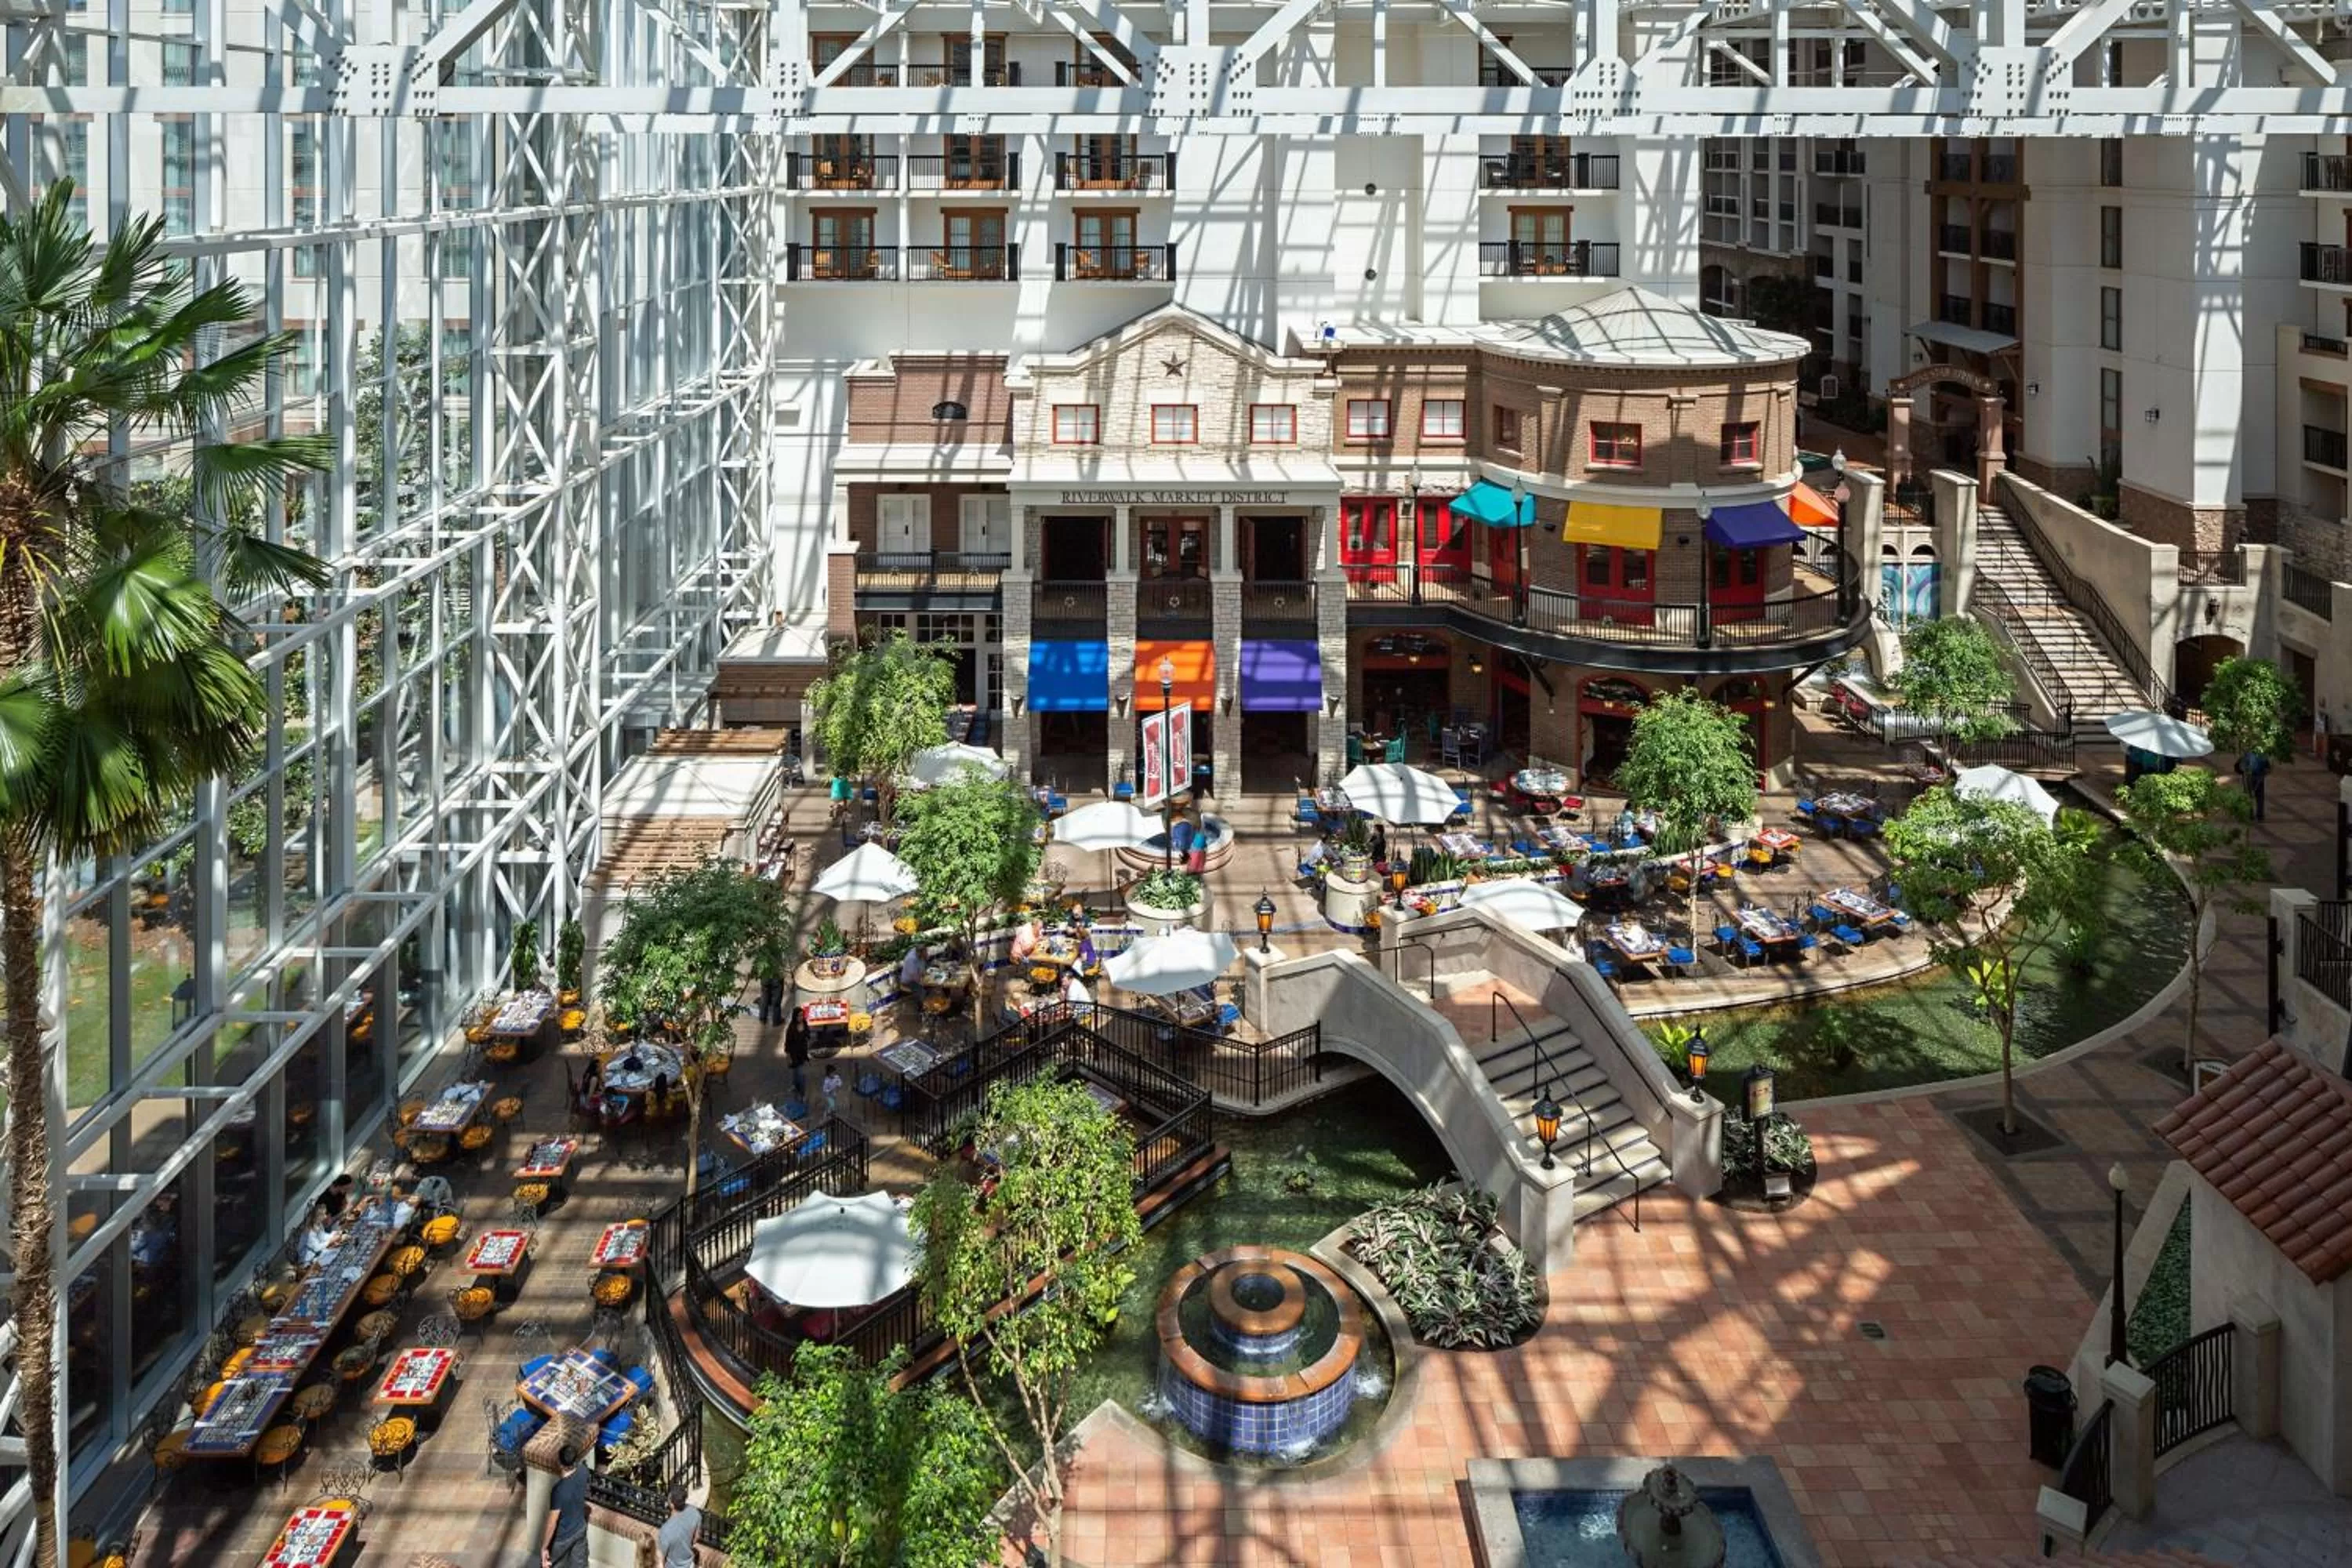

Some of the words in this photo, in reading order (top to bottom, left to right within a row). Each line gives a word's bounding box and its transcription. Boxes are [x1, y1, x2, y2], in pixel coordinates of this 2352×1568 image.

[1061, 491, 1145, 503] RIVERWALK
[1150, 491, 1216, 503] MARKET
[1220, 491, 1288, 503] DISTRICT
